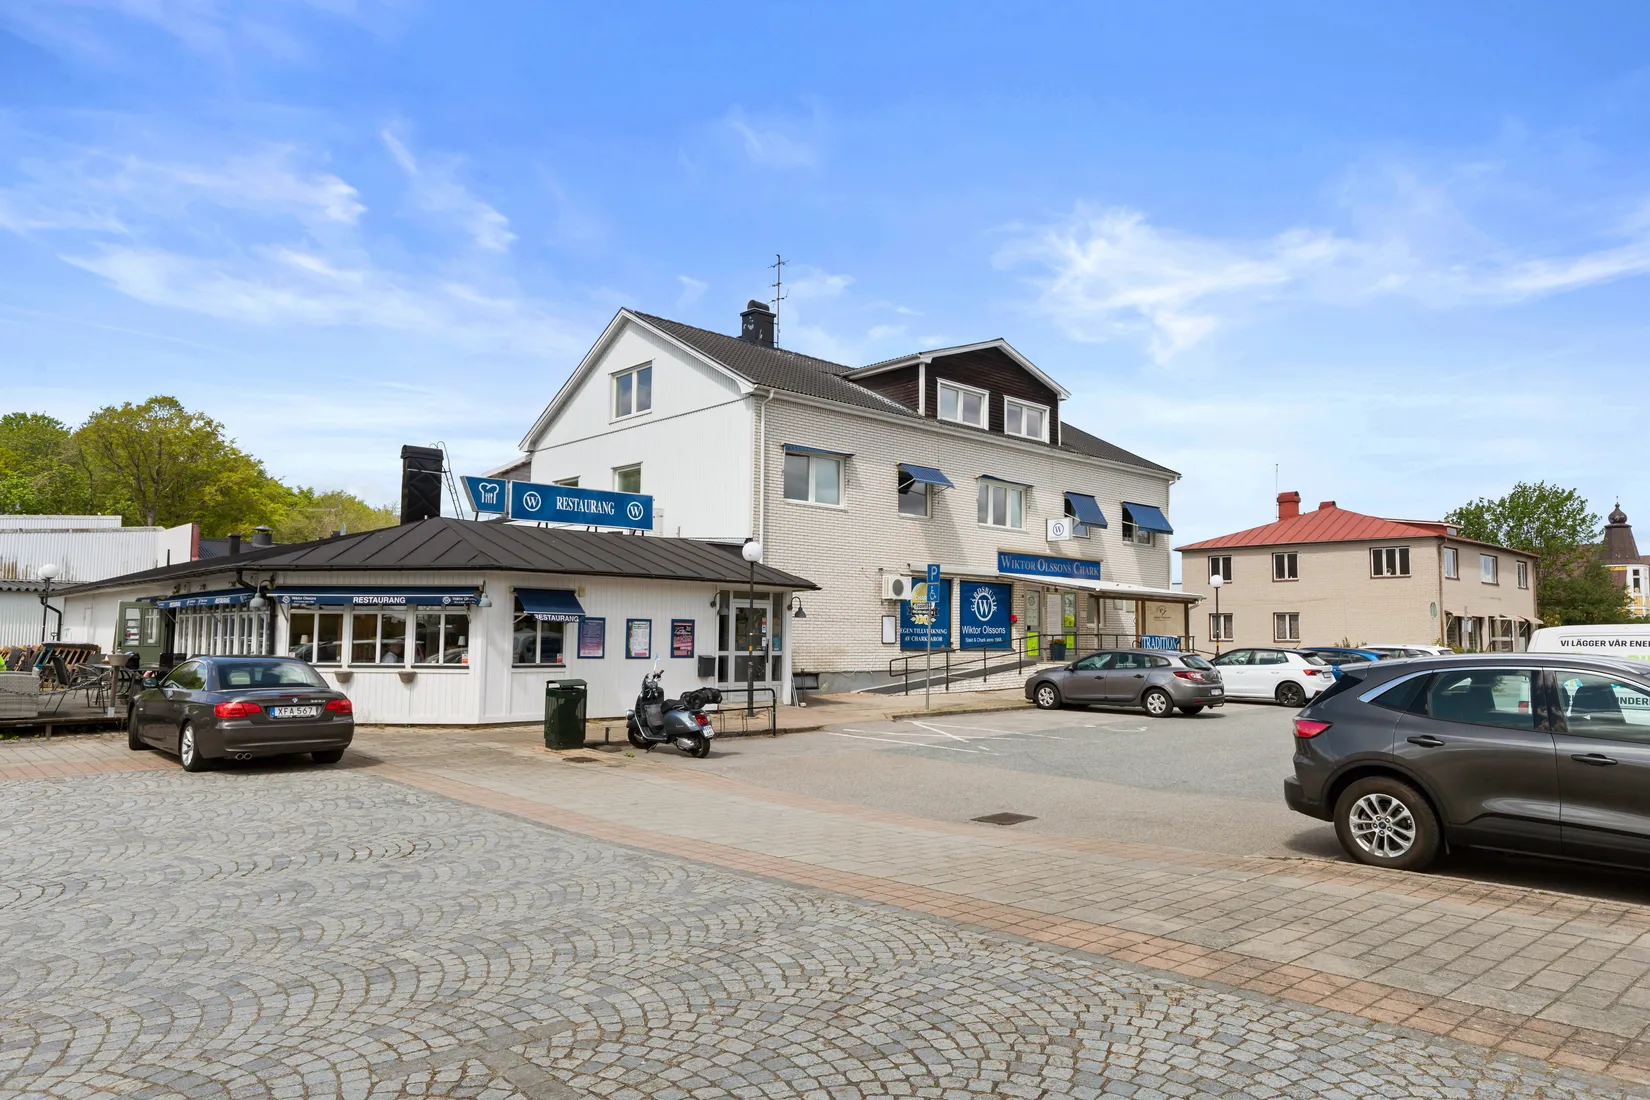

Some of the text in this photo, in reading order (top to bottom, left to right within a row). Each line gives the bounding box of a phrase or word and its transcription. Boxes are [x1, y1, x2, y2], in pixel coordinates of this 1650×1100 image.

[556, 496, 615, 515] RESTAURANG
[931, 566, 938, 581] P
[352, 596, 406, 604] RESTAURANG
[978, 599, 991, 616] W
[534, 614, 579, 622] RESTAURANG
[962, 625, 1006, 634] Wiktor Olssons
[1142, 636, 1177, 650] TRADITION
[1571, 638, 1607, 647] LÄGGER
[1608, 638, 1628, 647] VÅR
[1617, 696, 1650, 705] NDER
[278, 706, 313, 715] XFA 567
